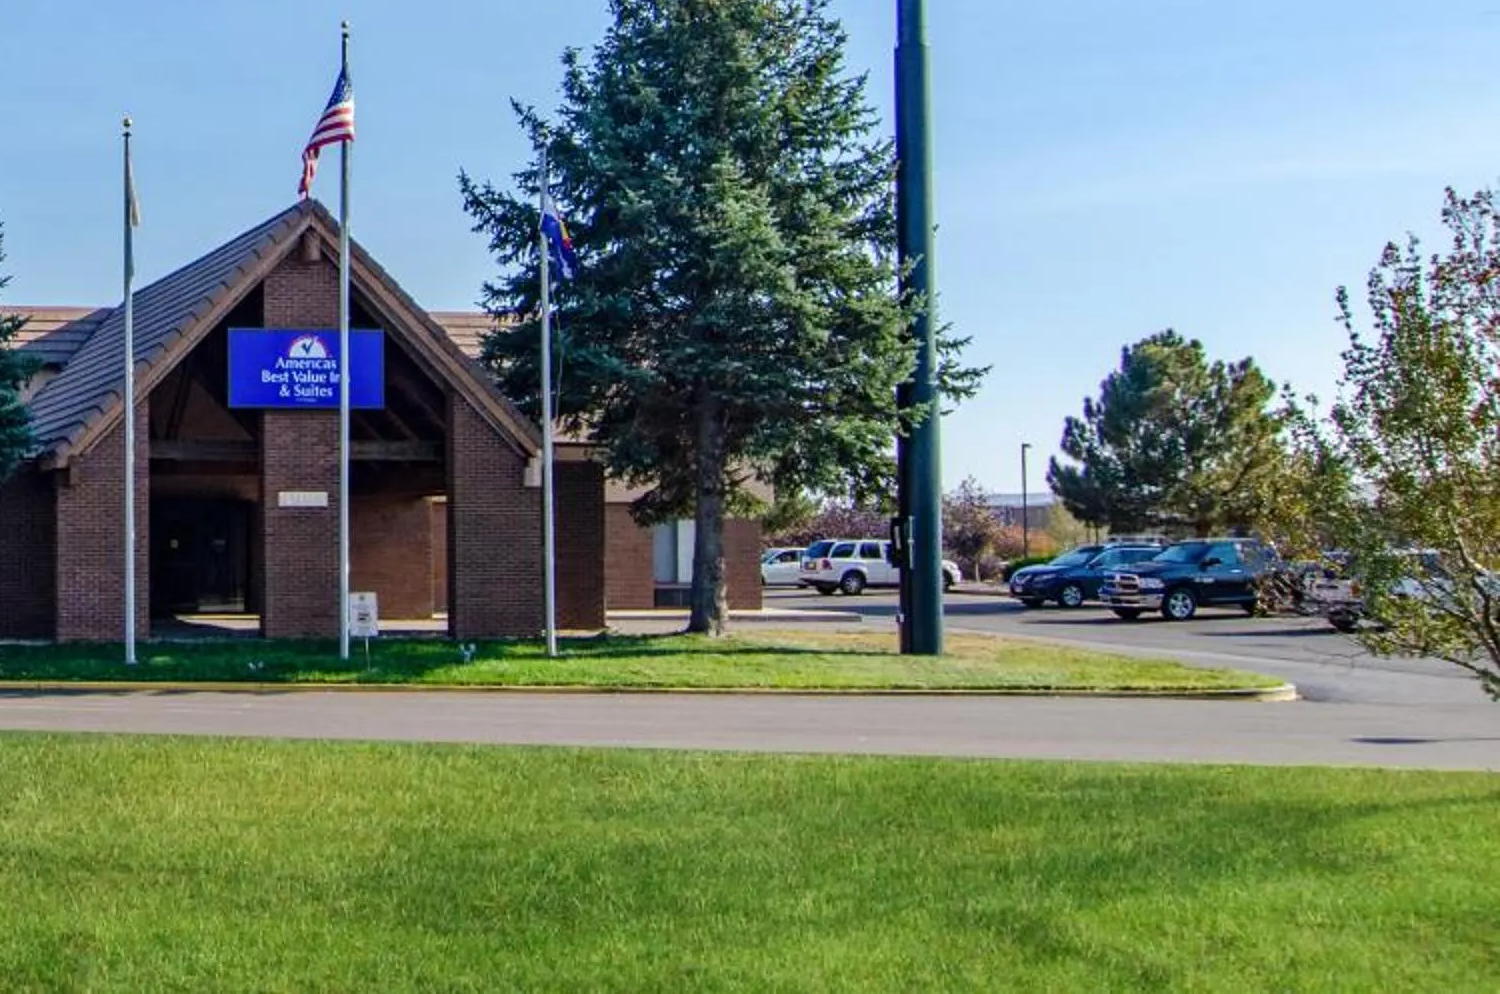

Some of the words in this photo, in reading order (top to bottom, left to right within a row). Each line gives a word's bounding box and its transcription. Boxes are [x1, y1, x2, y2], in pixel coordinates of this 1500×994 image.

[276, 357, 337, 369] Americas
[262, 369, 289, 383] Best
[292, 370, 327, 383] Value
[329, 371, 350, 383] In
[279, 384, 291, 397] &
[294, 384, 333, 397] Suites
